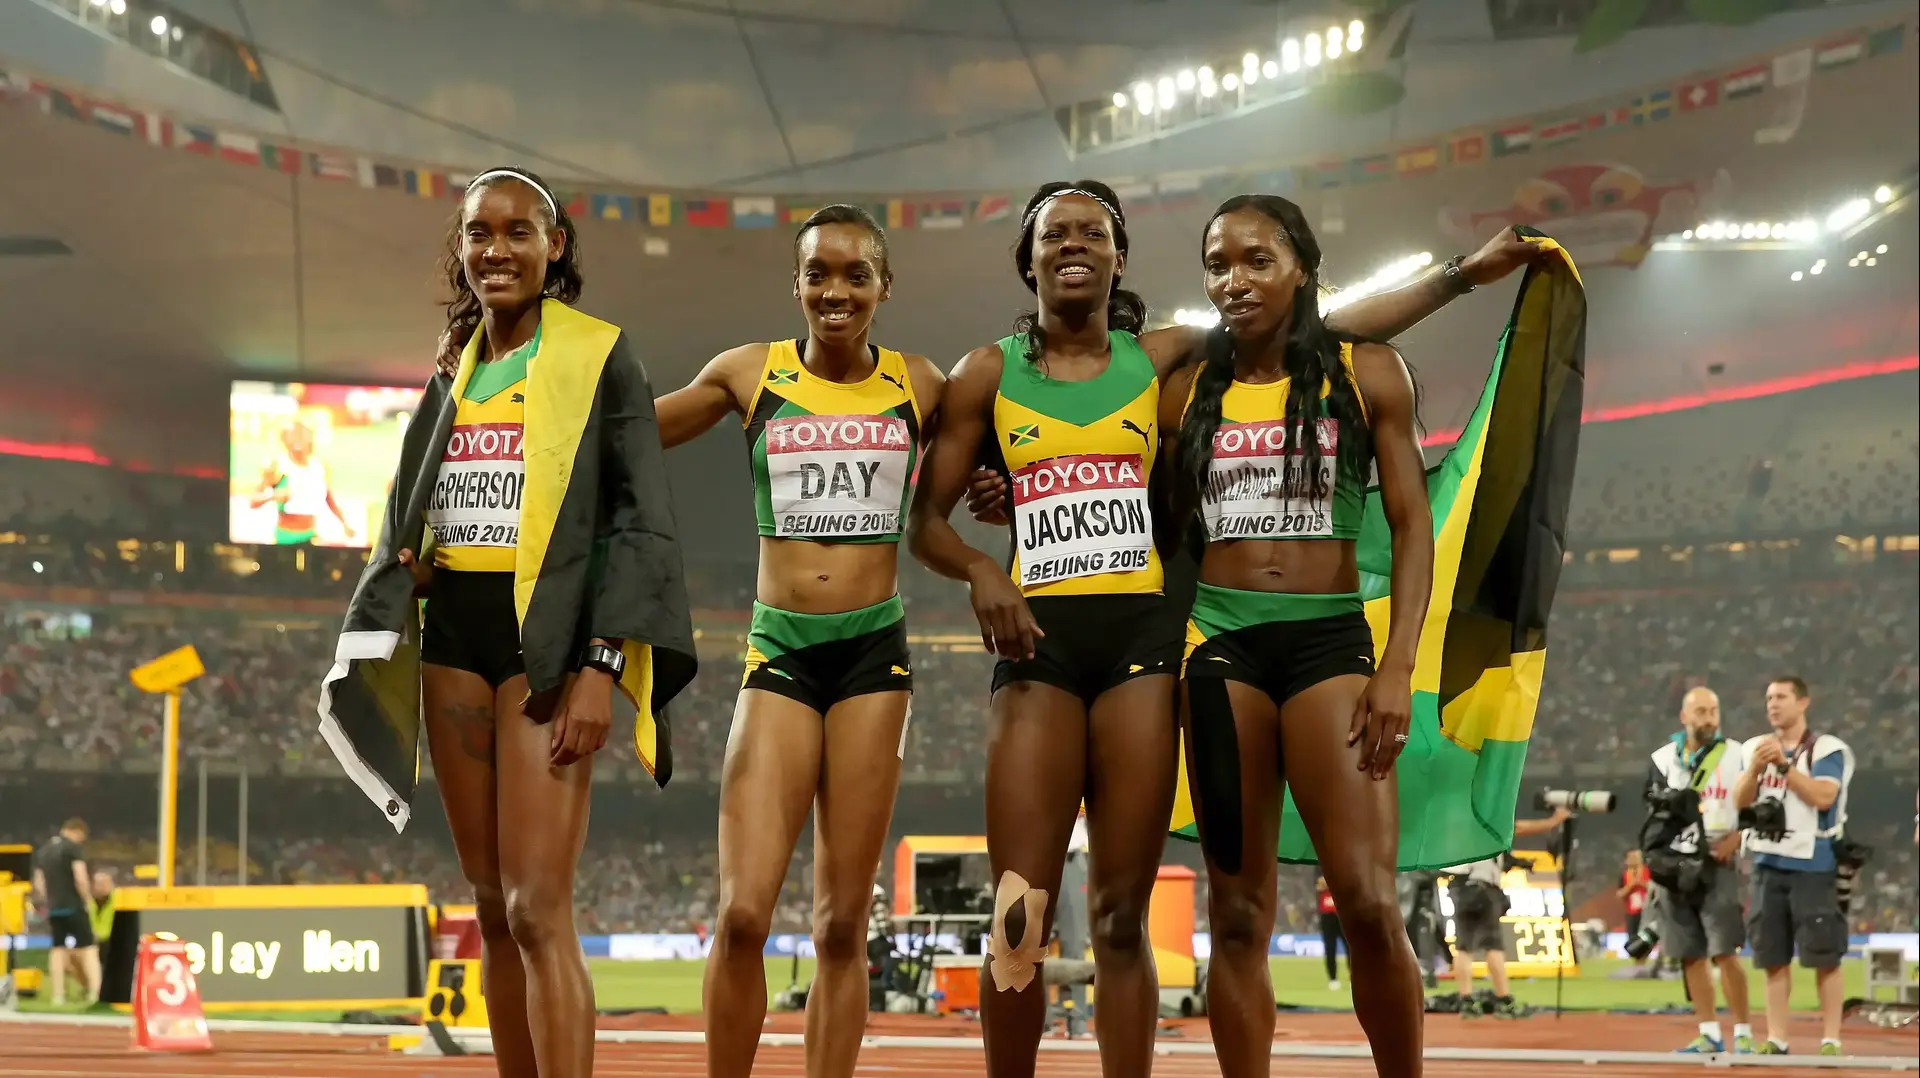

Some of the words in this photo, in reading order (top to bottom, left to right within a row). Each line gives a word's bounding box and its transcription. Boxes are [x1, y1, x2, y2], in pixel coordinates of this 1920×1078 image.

[447, 430, 525, 457] OYOT
[773, 421, 905, 448] TOYOTA
[799, 461, 881, 500] DAY
[1017, 461, 1140, 498] TOYOTA
[782, 513, 857, 533] BEIJING
[1023, 498, 1146, 551] JACKSON
[1215, 516, 1276, 538] EIJING
[1279, 514, 1324, 533] 2015
[1026, 552, 1104, 582] BEIJING
[1108, 549, 1148, 570] 2015
[155, 931, 281, 980] elay
[303, 929, 380, 974] Men
[154, 954, 187, 1006] 3
